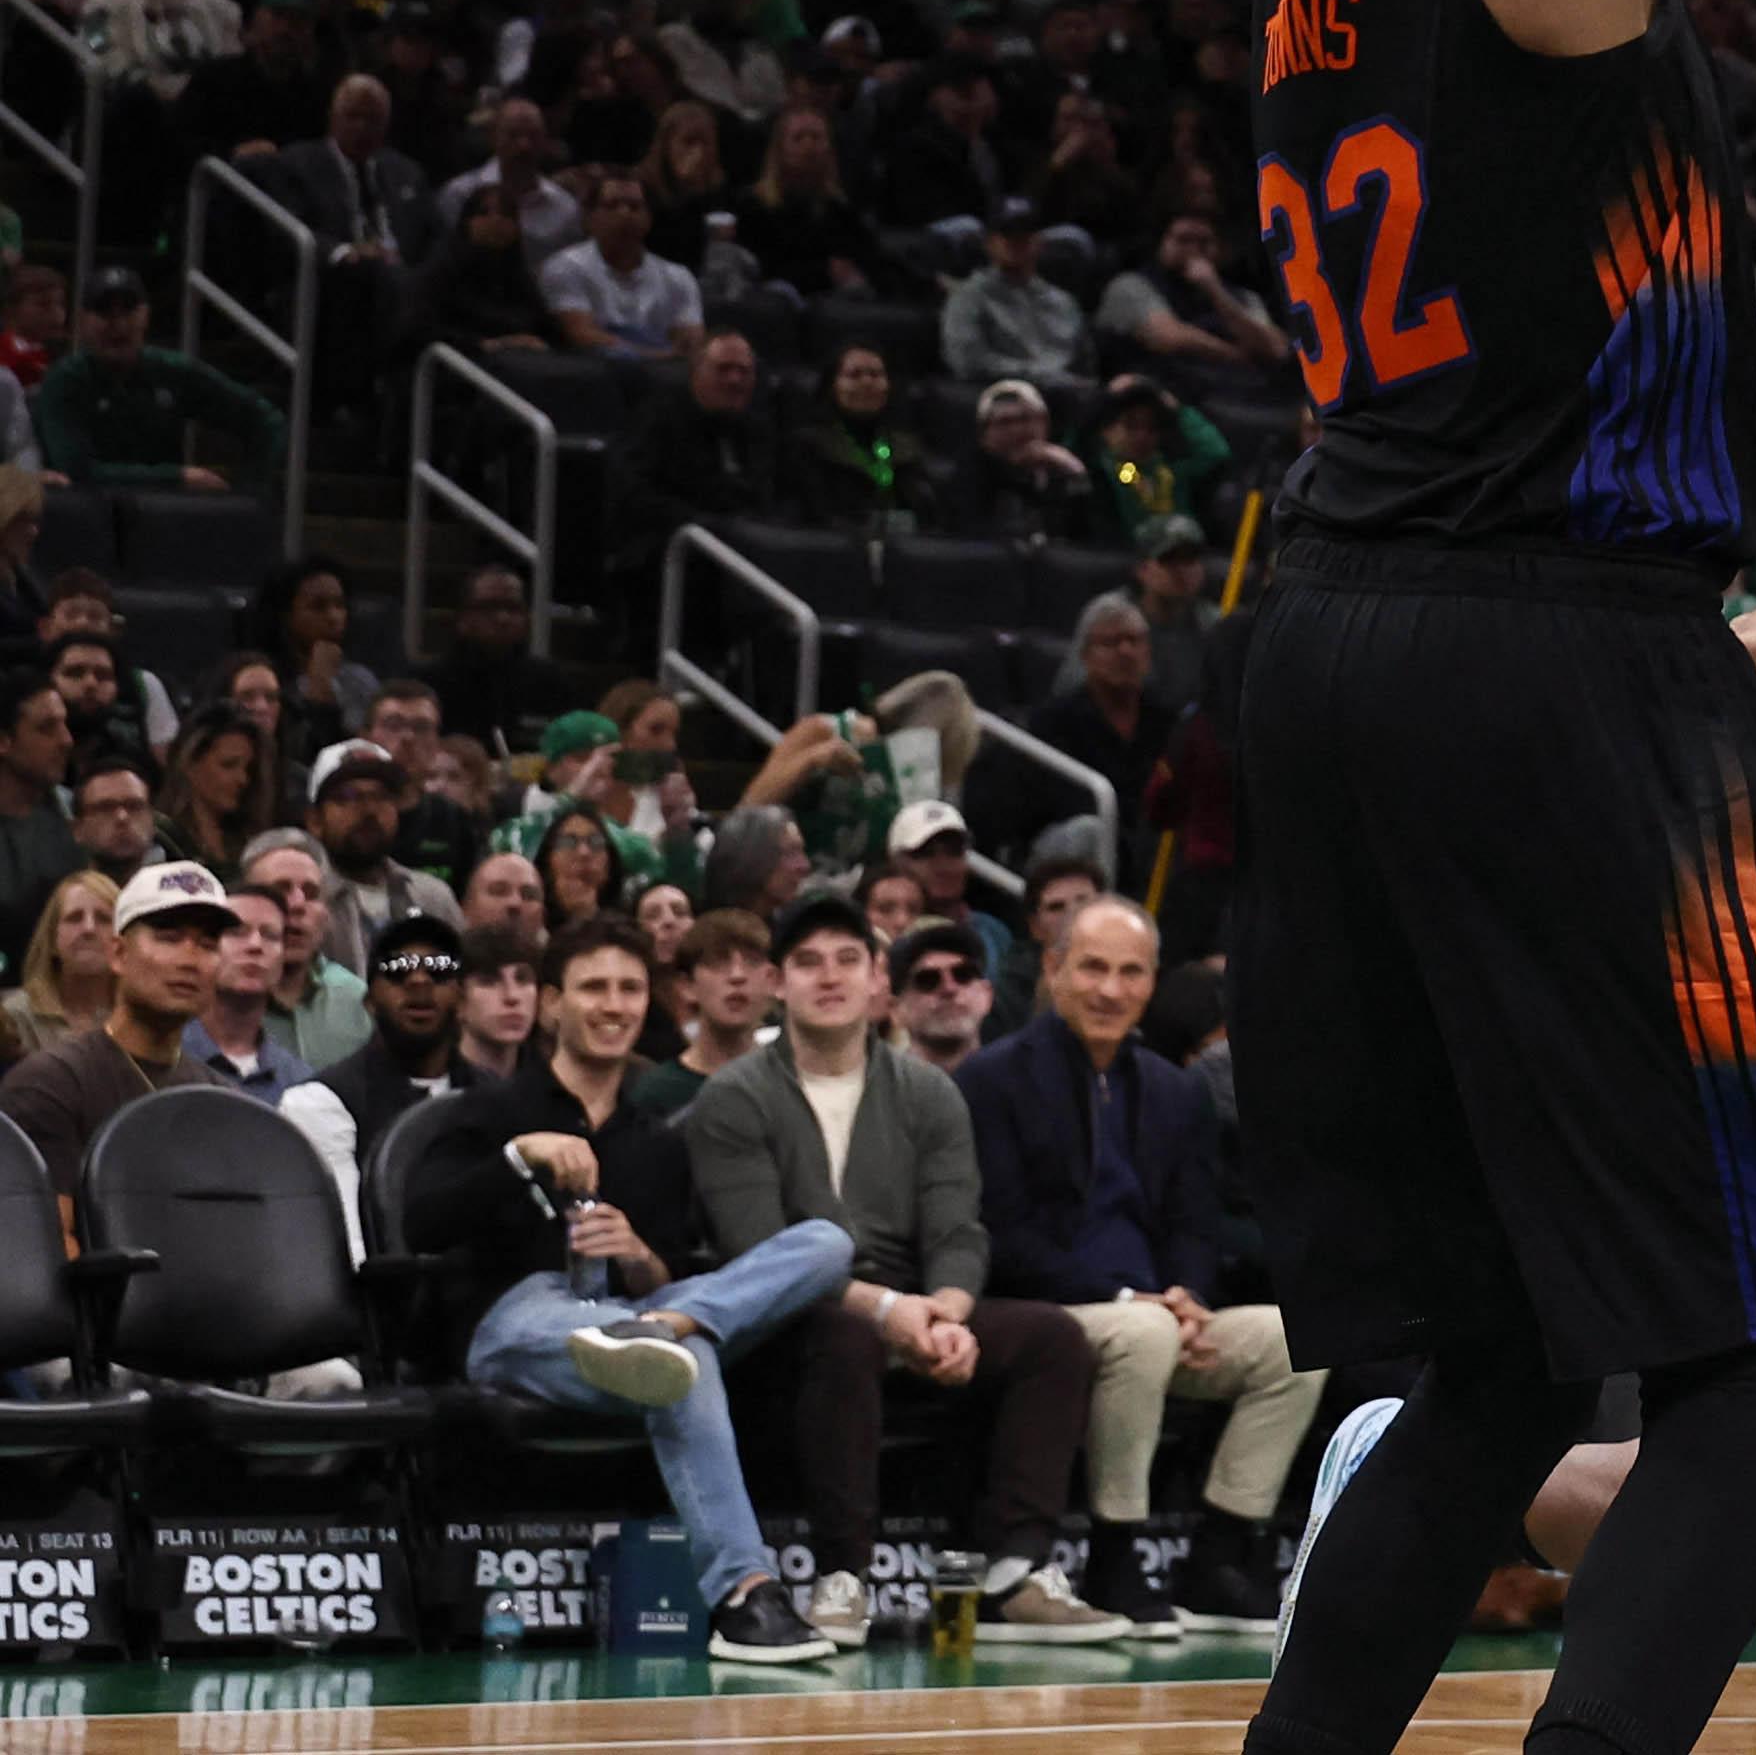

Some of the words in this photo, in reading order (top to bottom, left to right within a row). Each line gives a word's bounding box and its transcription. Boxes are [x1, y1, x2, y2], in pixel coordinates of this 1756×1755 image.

[1258, 117, 1473, 409] 32
[92, 1532, 113, 1548] 13
[157, 1530, 193, 1546] FLR
[232, 1529, 277, 1545] ROW
[326, 1528, 371, 1543] SEAT
[377, 1527, 399, 1543] 14
[184, 1552, 384, 1594] BOSTON
[194, 1594, 378, 1637] CELTICS
